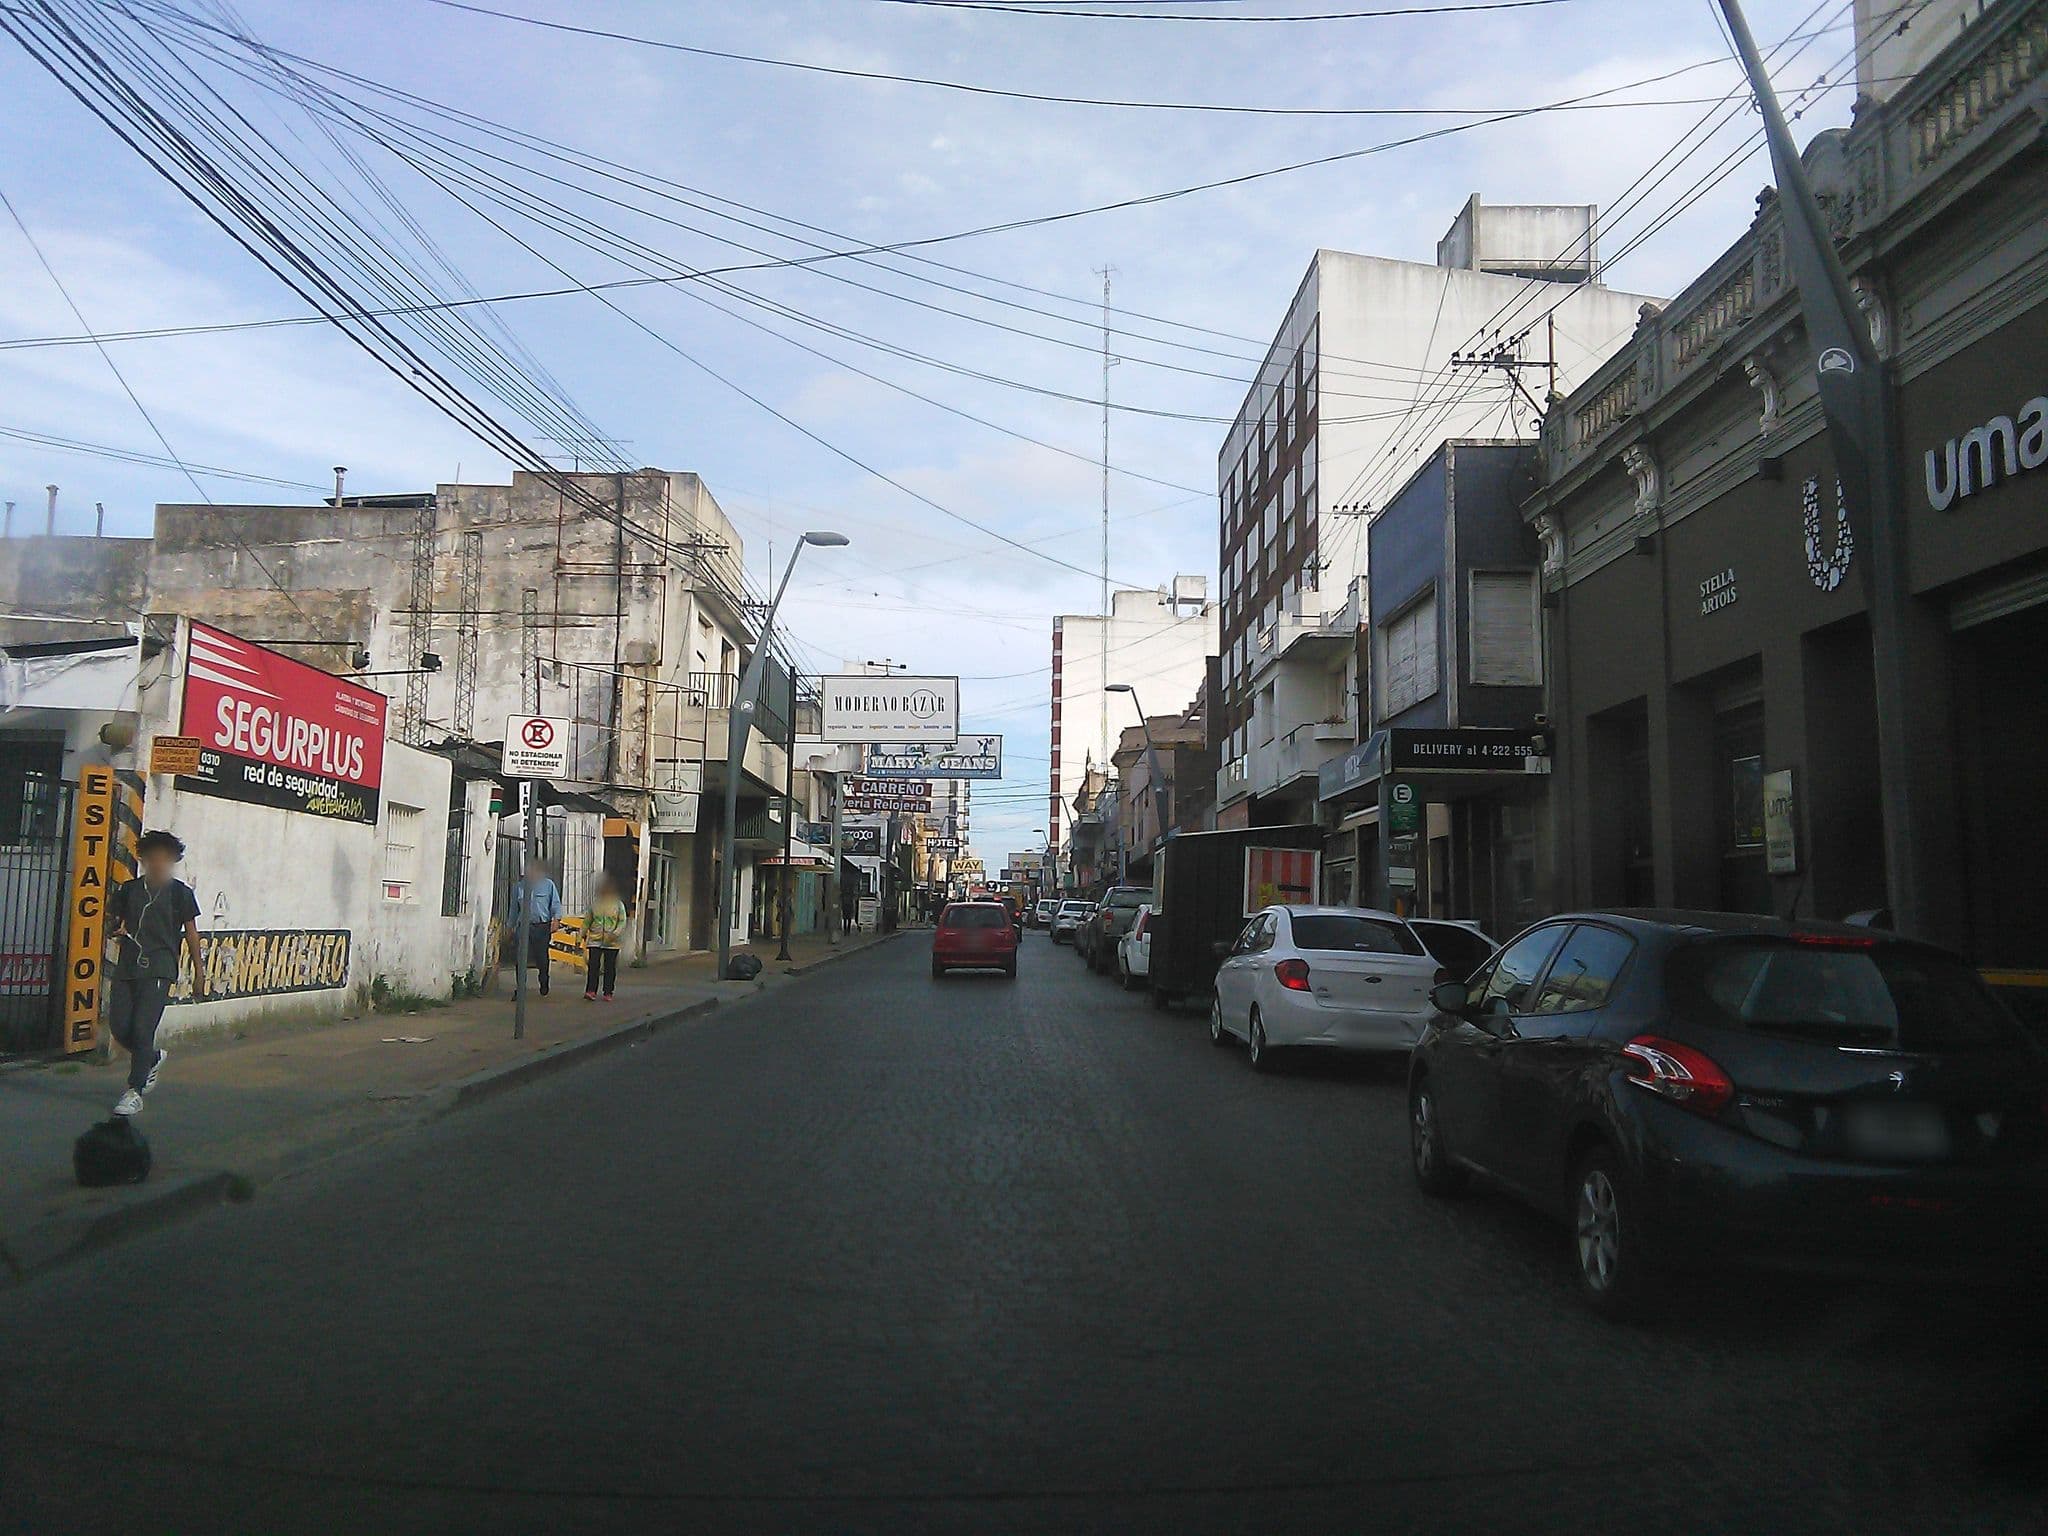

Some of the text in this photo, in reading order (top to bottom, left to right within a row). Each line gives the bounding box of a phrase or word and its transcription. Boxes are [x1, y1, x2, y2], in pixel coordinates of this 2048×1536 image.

[1700, 568, 1735, 597] STELLA
[1701, 587, 1736, 615] ARTOIS
[834, 696, 945, 712] MODERNO BAZAR
[215, 695, 364, 780] SEGURPLUS
[521, 751, 562, 760] ESTACIONAR
[1413, 743, 1462, 755] DELIVERY
[1467, 745, 1477, 755] al
[201, 752, 221, 766] 0310
[520, 759, 560, 767] DETENERSE
[870, 755, 997, 770] MARY JEANS
[243, 763, 265, 784] red
[267, 766, 283, 787] de
[284, 773, 339, 799] seguridad
[1397, 787, 1408, 800] E
[954, 862, 979, 870] WAY
[72, 774, 107, 1043] ESTACIONE
